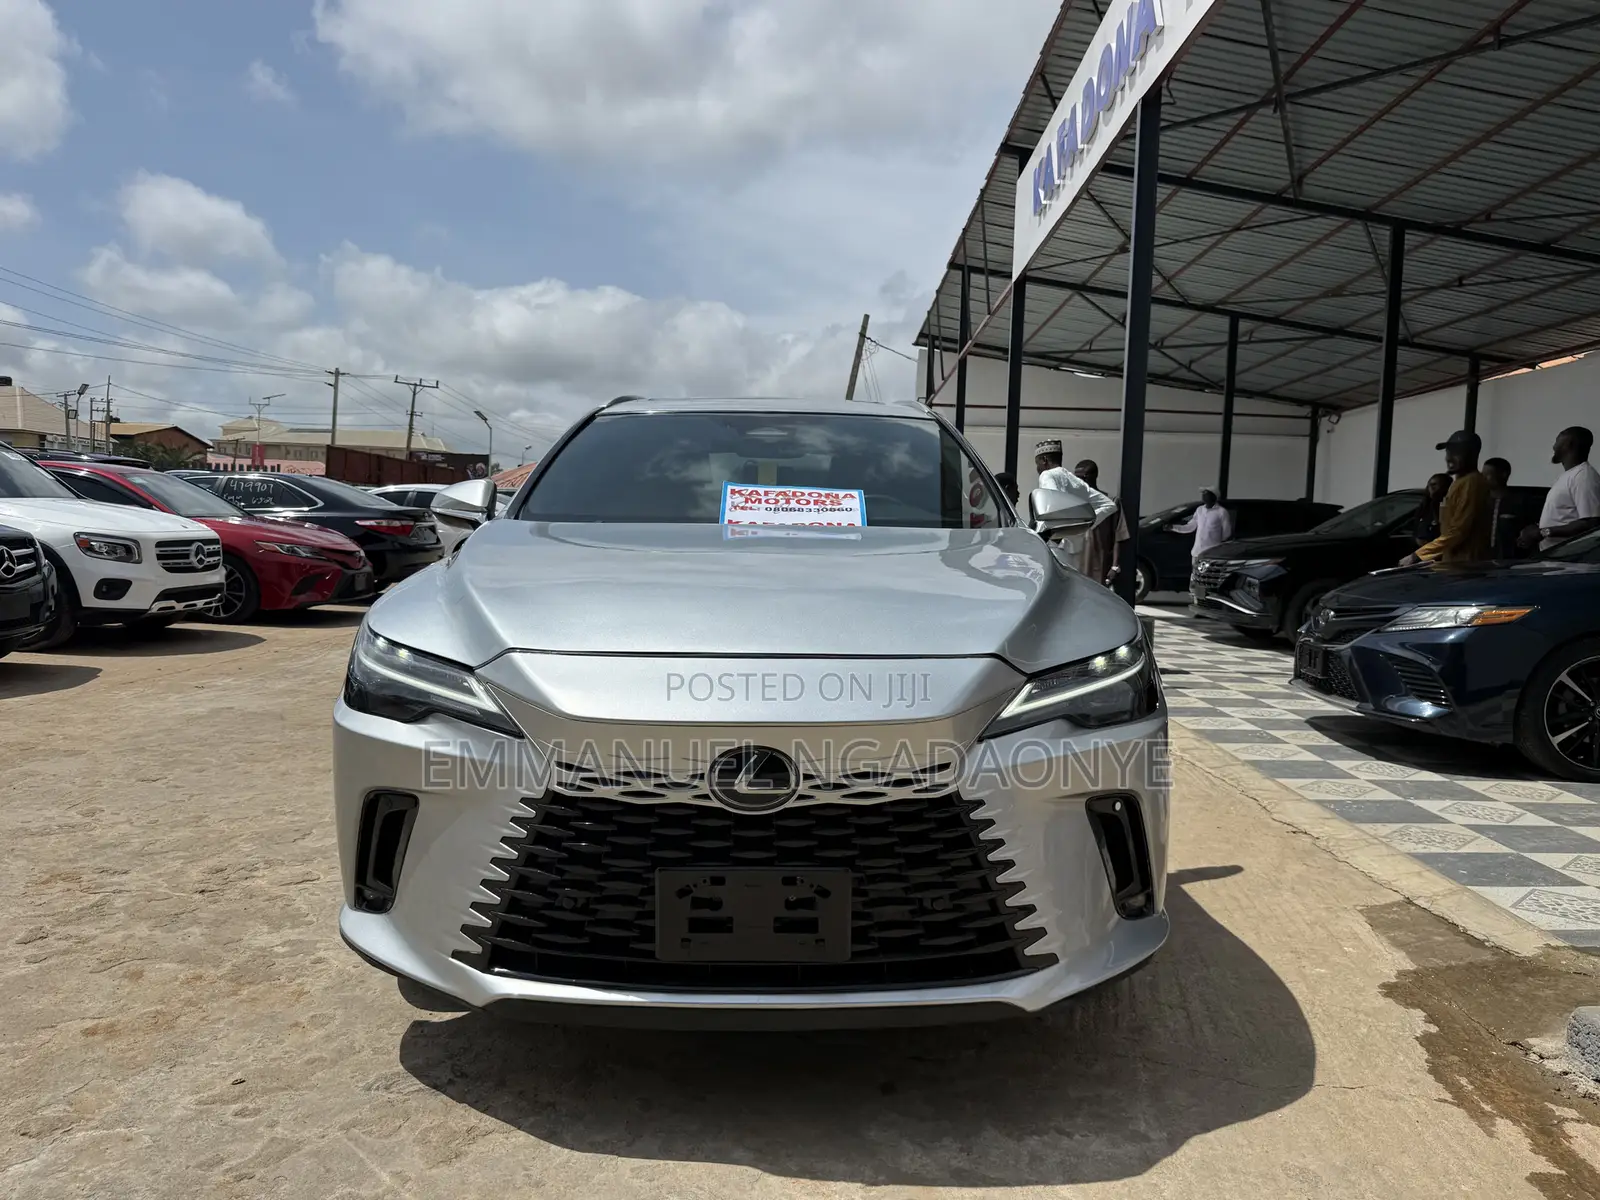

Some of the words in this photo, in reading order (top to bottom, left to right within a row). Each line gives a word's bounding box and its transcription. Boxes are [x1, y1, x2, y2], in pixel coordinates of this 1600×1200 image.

[1033, 0, 1164, 216] KAFADONA
[729, 488, 858, 499] KAFADONA
[744, 497, 843, 506] MOTORS
